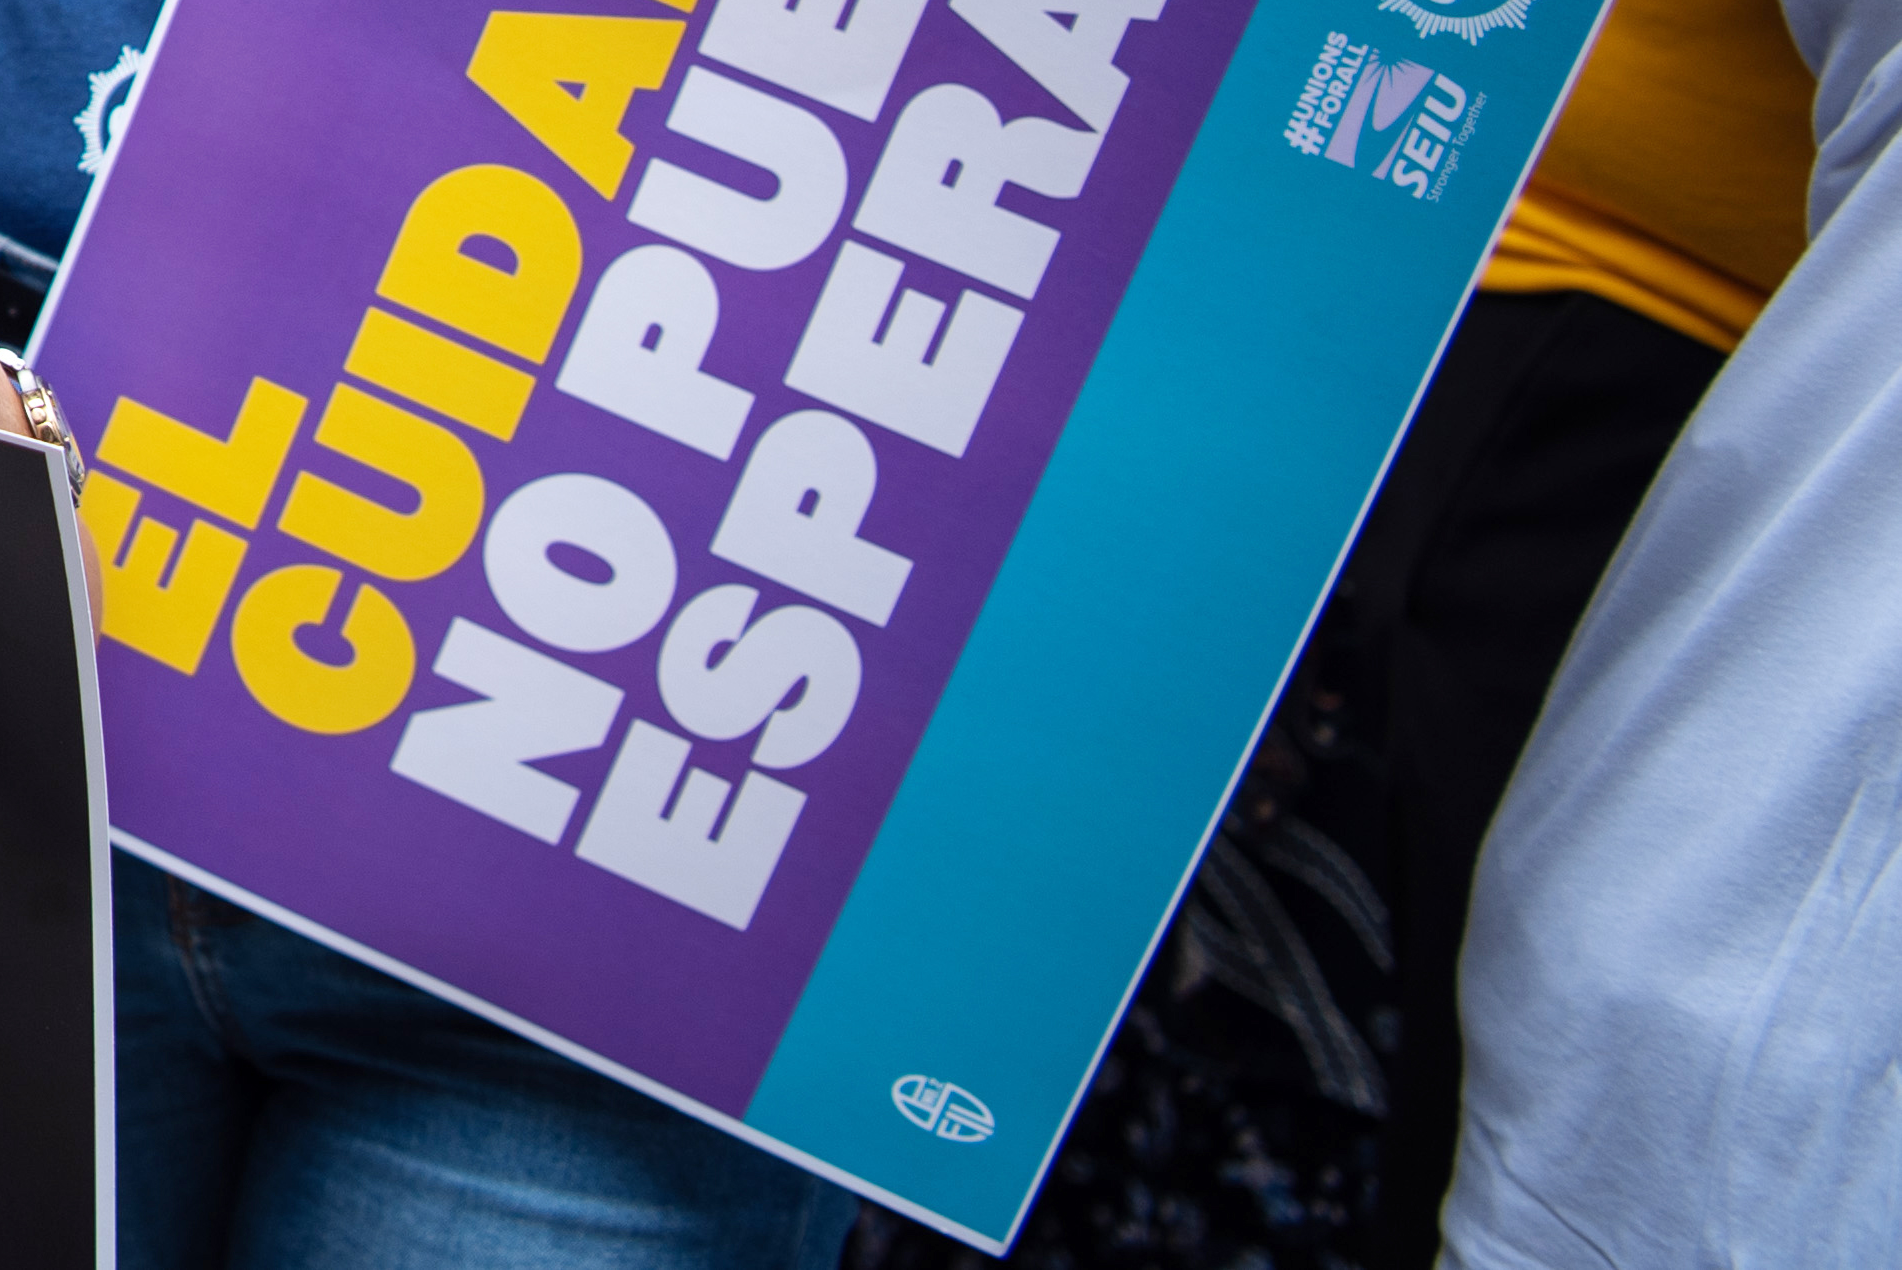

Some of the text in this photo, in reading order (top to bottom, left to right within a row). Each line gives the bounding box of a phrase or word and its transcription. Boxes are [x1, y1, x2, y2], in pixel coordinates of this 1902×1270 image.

[1311, 43, 1369, 129] FORALL
[1392, 73, 1468, 200] SEIU
[1426, 90, 1489, 204] Stronger Together
[77, 372, 308, 680] EL
[391, 470, 679, 845] NO
